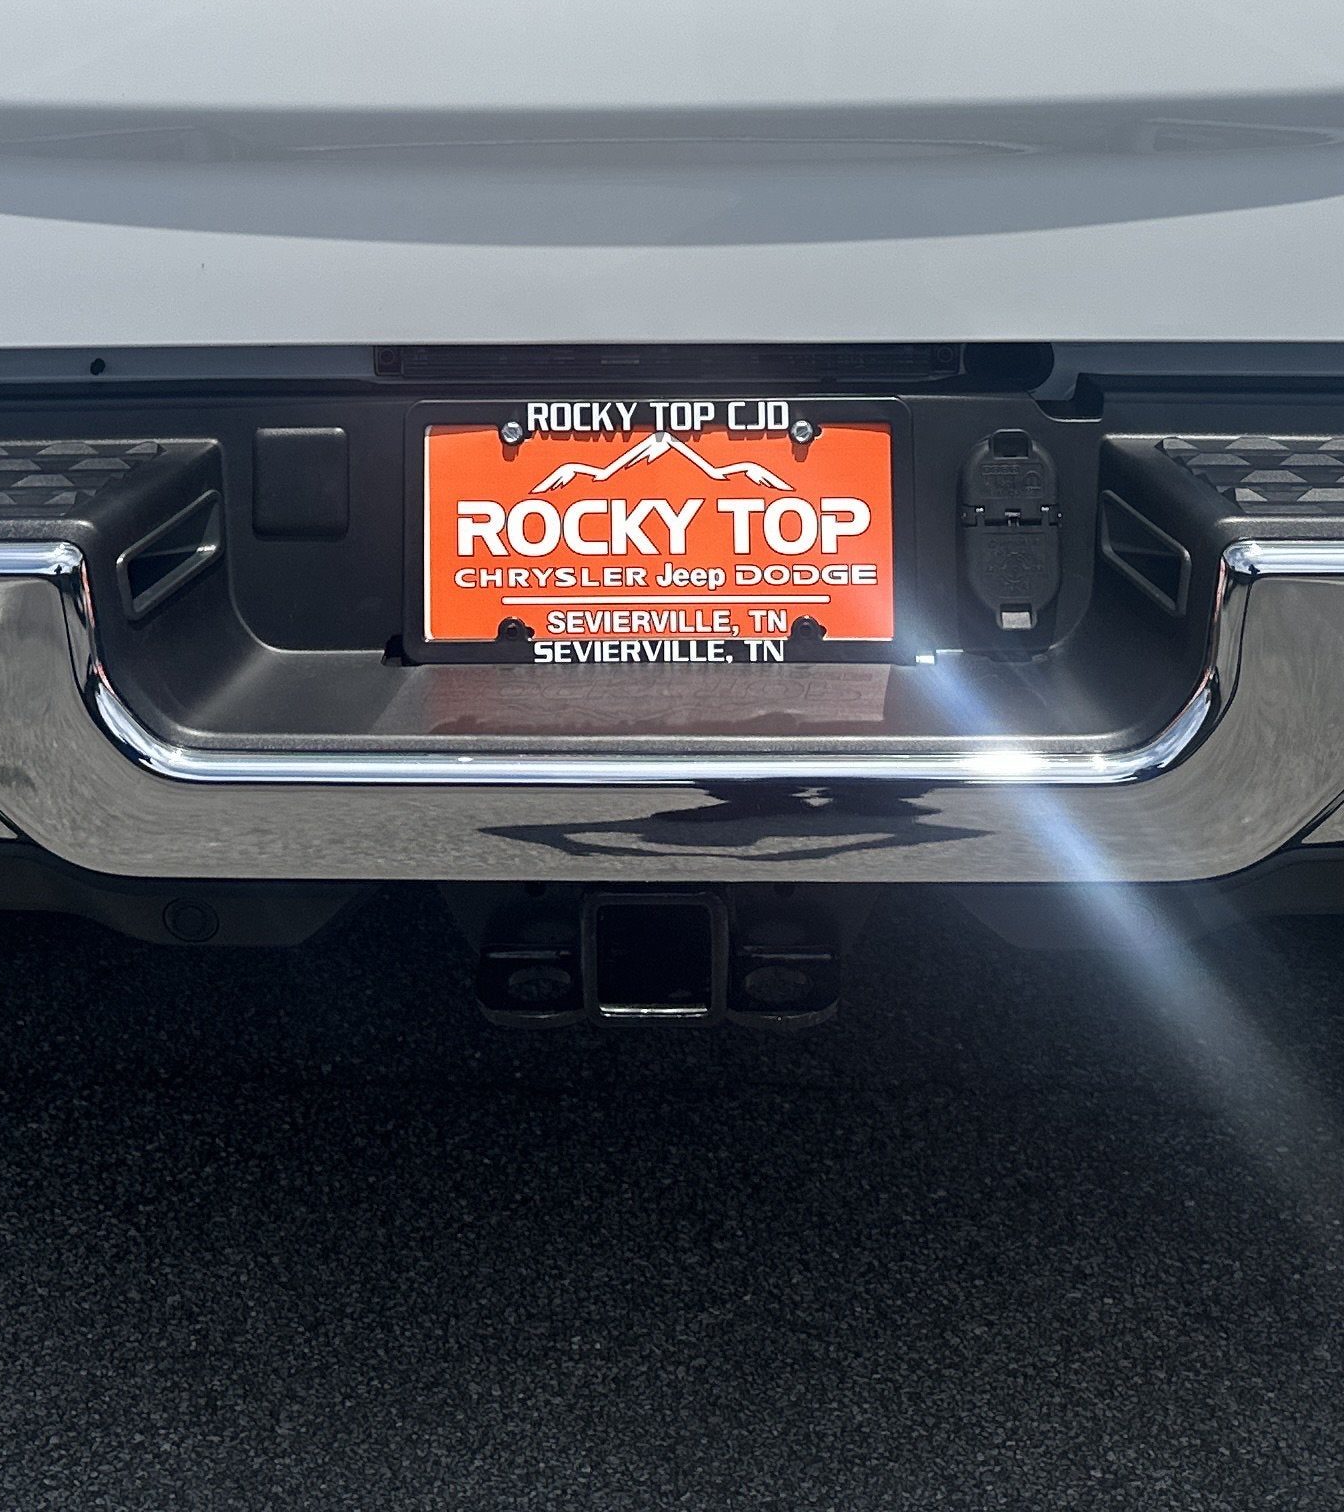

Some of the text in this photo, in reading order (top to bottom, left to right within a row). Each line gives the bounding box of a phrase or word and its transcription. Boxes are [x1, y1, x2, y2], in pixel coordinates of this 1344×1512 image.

[526, 400, 790, 432] ROCKY TOP CJD
[456, 497, 872, 558] ROCKY TOP
[454, 562, 878, 590] CHRYSLER Jeep DODGE
[546, 609, 788, 637] SEVIERVILLE, TN
[533, 640, 786, 664] SEVIERVILLE, TN
